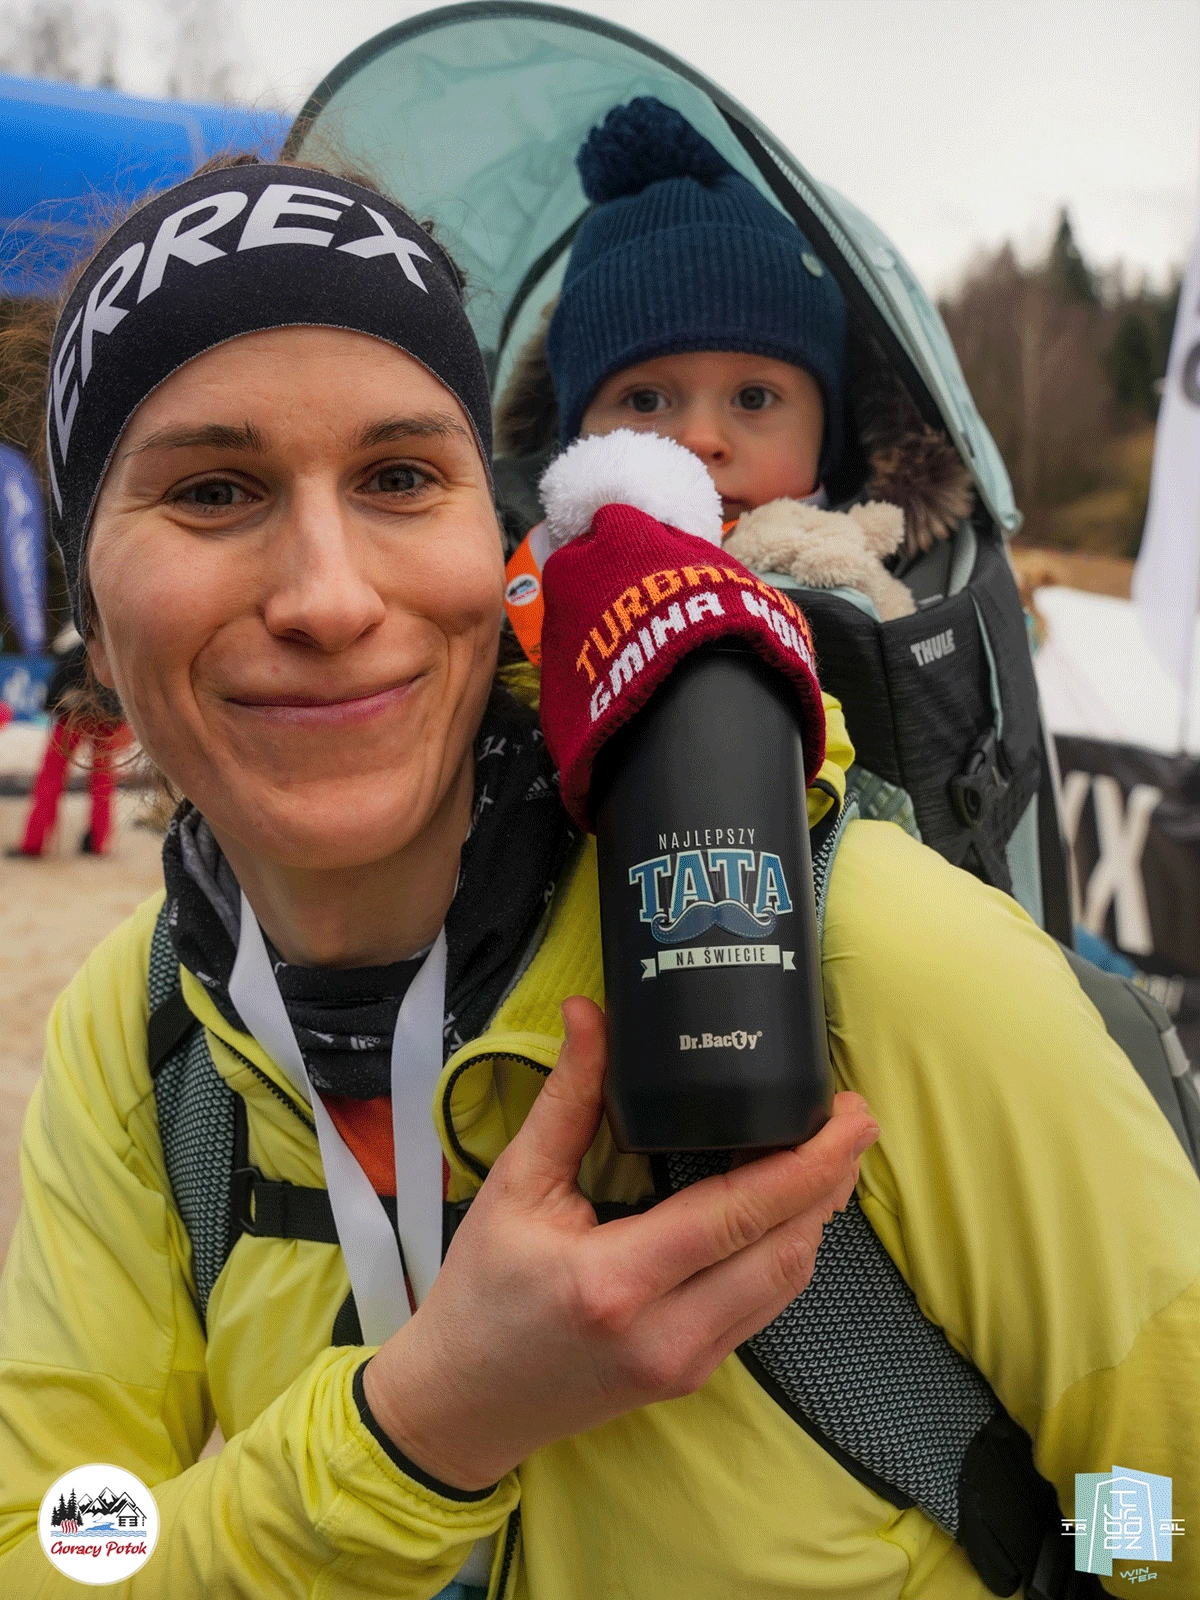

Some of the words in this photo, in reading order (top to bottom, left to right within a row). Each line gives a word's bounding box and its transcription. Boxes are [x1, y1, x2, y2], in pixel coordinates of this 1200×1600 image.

[47, 184, 433, 520] ERREX
[590, 592, 726, 722] GMINA
[911, 629, 956, 667] THULE
[658, 828, 756, 850] NAJLEPSZY
[628, 848, 794, 924] TATA
[675, 952, 695, 967] NA
[704, 946, 767, 965] ŚWIECIE
